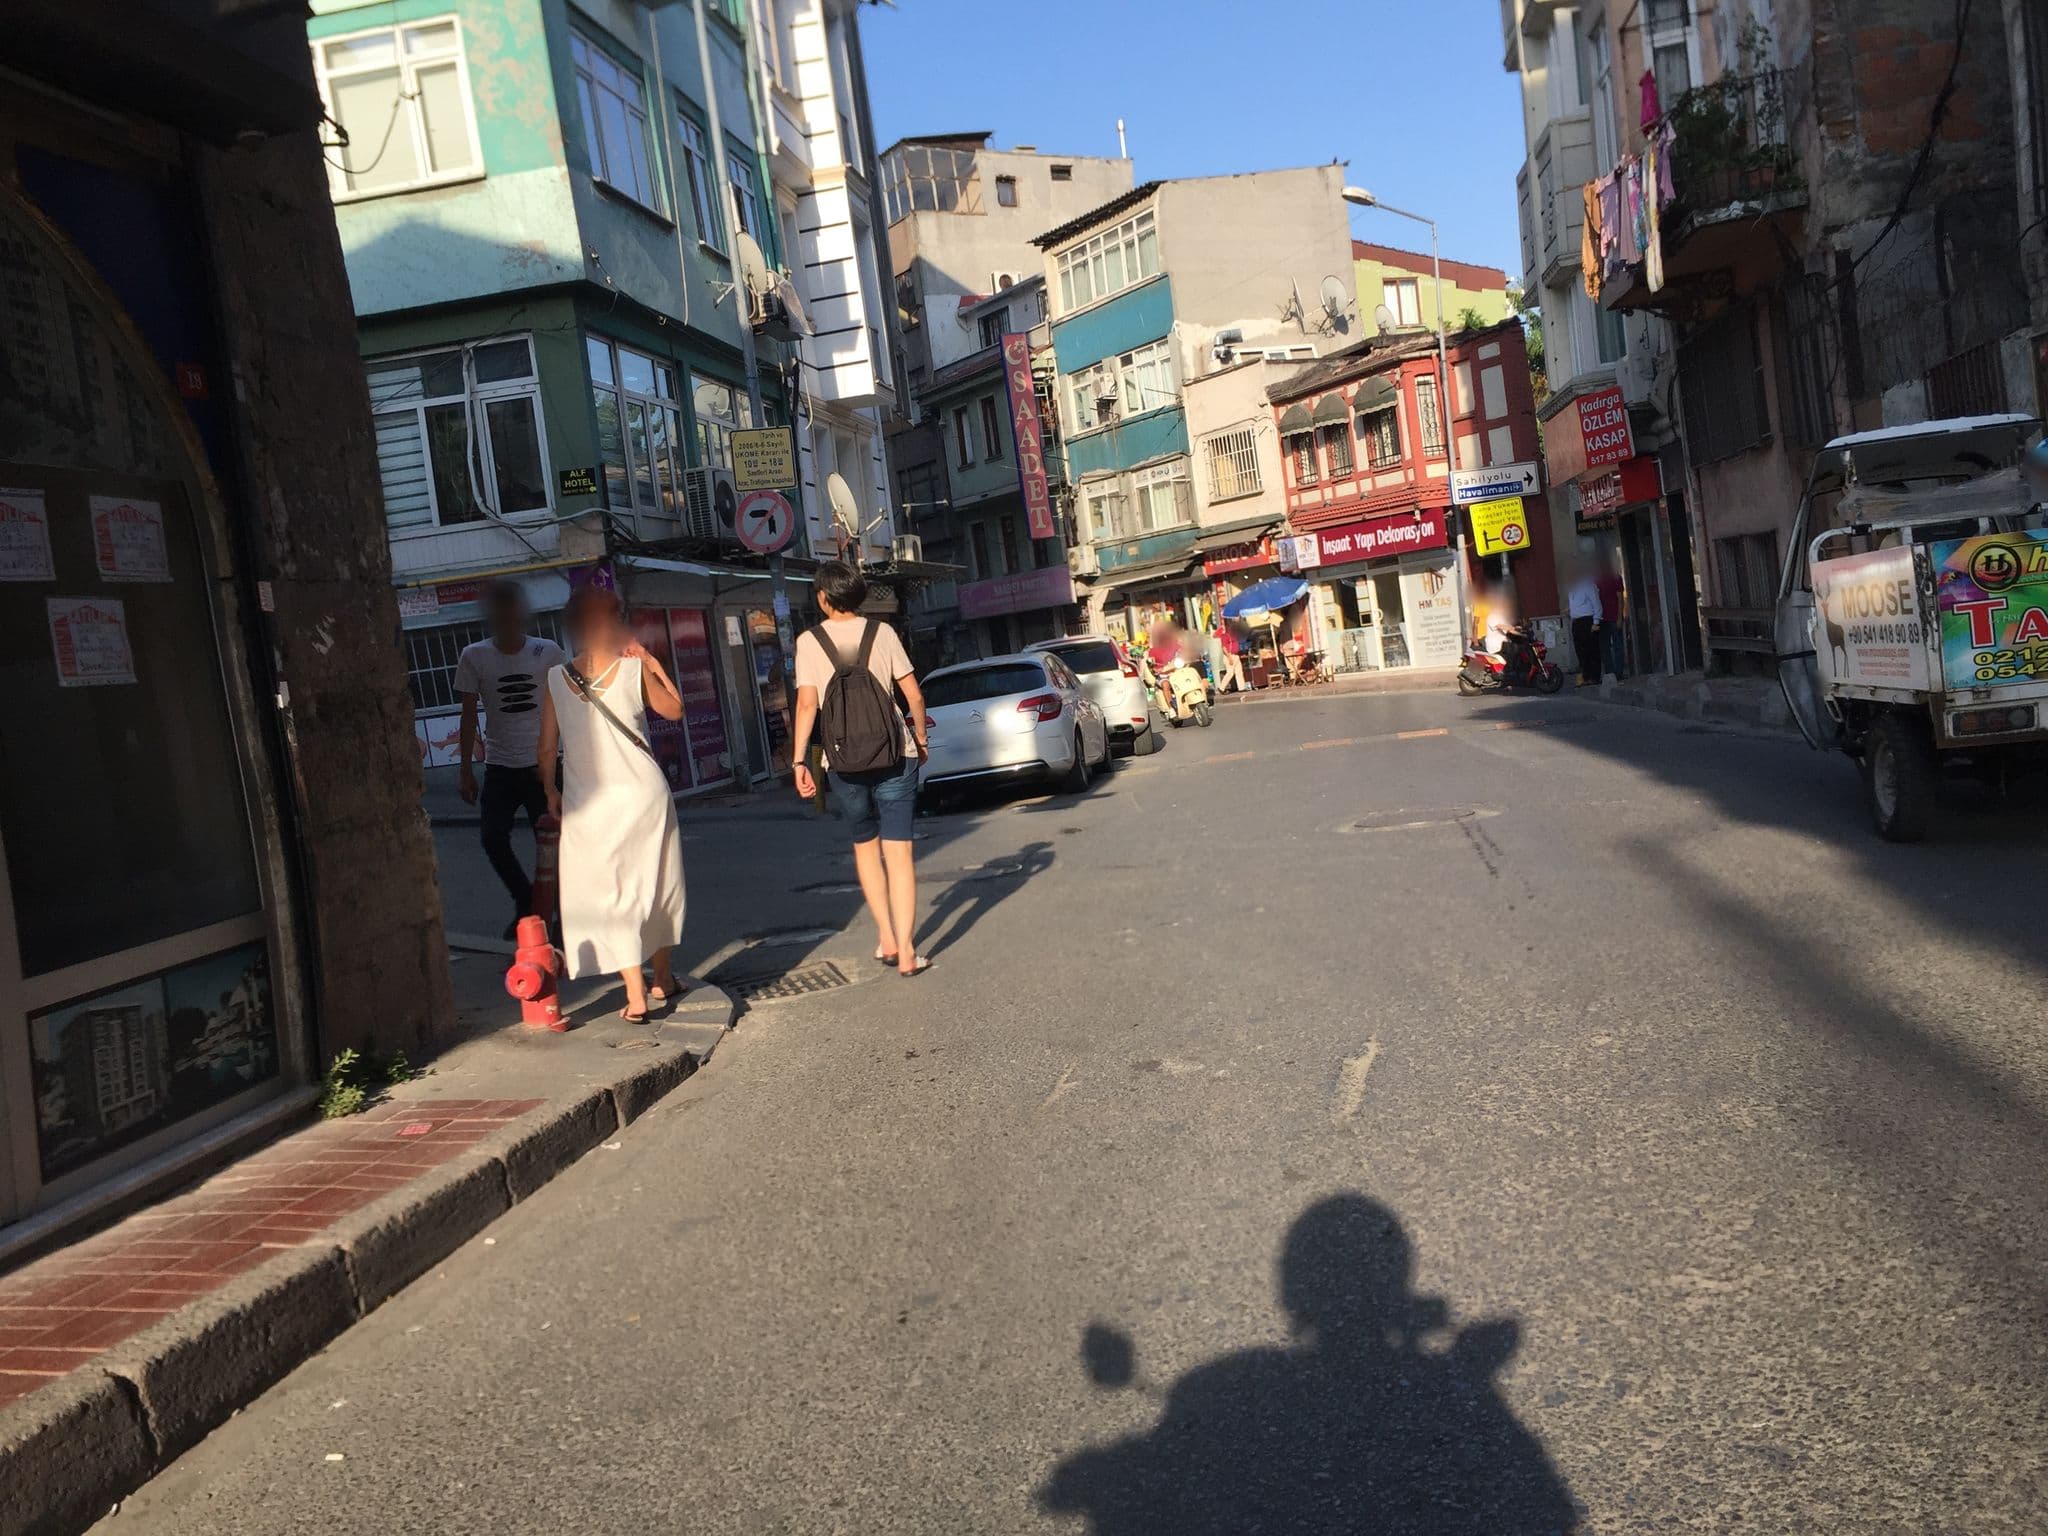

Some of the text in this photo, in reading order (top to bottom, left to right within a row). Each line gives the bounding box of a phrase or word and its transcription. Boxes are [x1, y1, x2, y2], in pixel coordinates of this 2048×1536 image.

[1580, 394, 1620, 413] Kadırga
[1582, 408, 1623, 432] ÖZLEM
[1014, 370, 1047, 528] SAADET
[1585, 429, 1626, 451] KASAP
[564, 479, 593, 487] HOTEL
[1456, 472, 1511, 486] Sahilyolu
[1458, 486, 1513, 498] Havalimanı
[1322, 521, 1435, 556] İnşaat Yapı Dekorasyon
[1418, 600, 1432, 609] HM
[1841, 579, 1914, 618] MOOSE
[1848, 622, 1920, 644] +90 541 418 90 89
